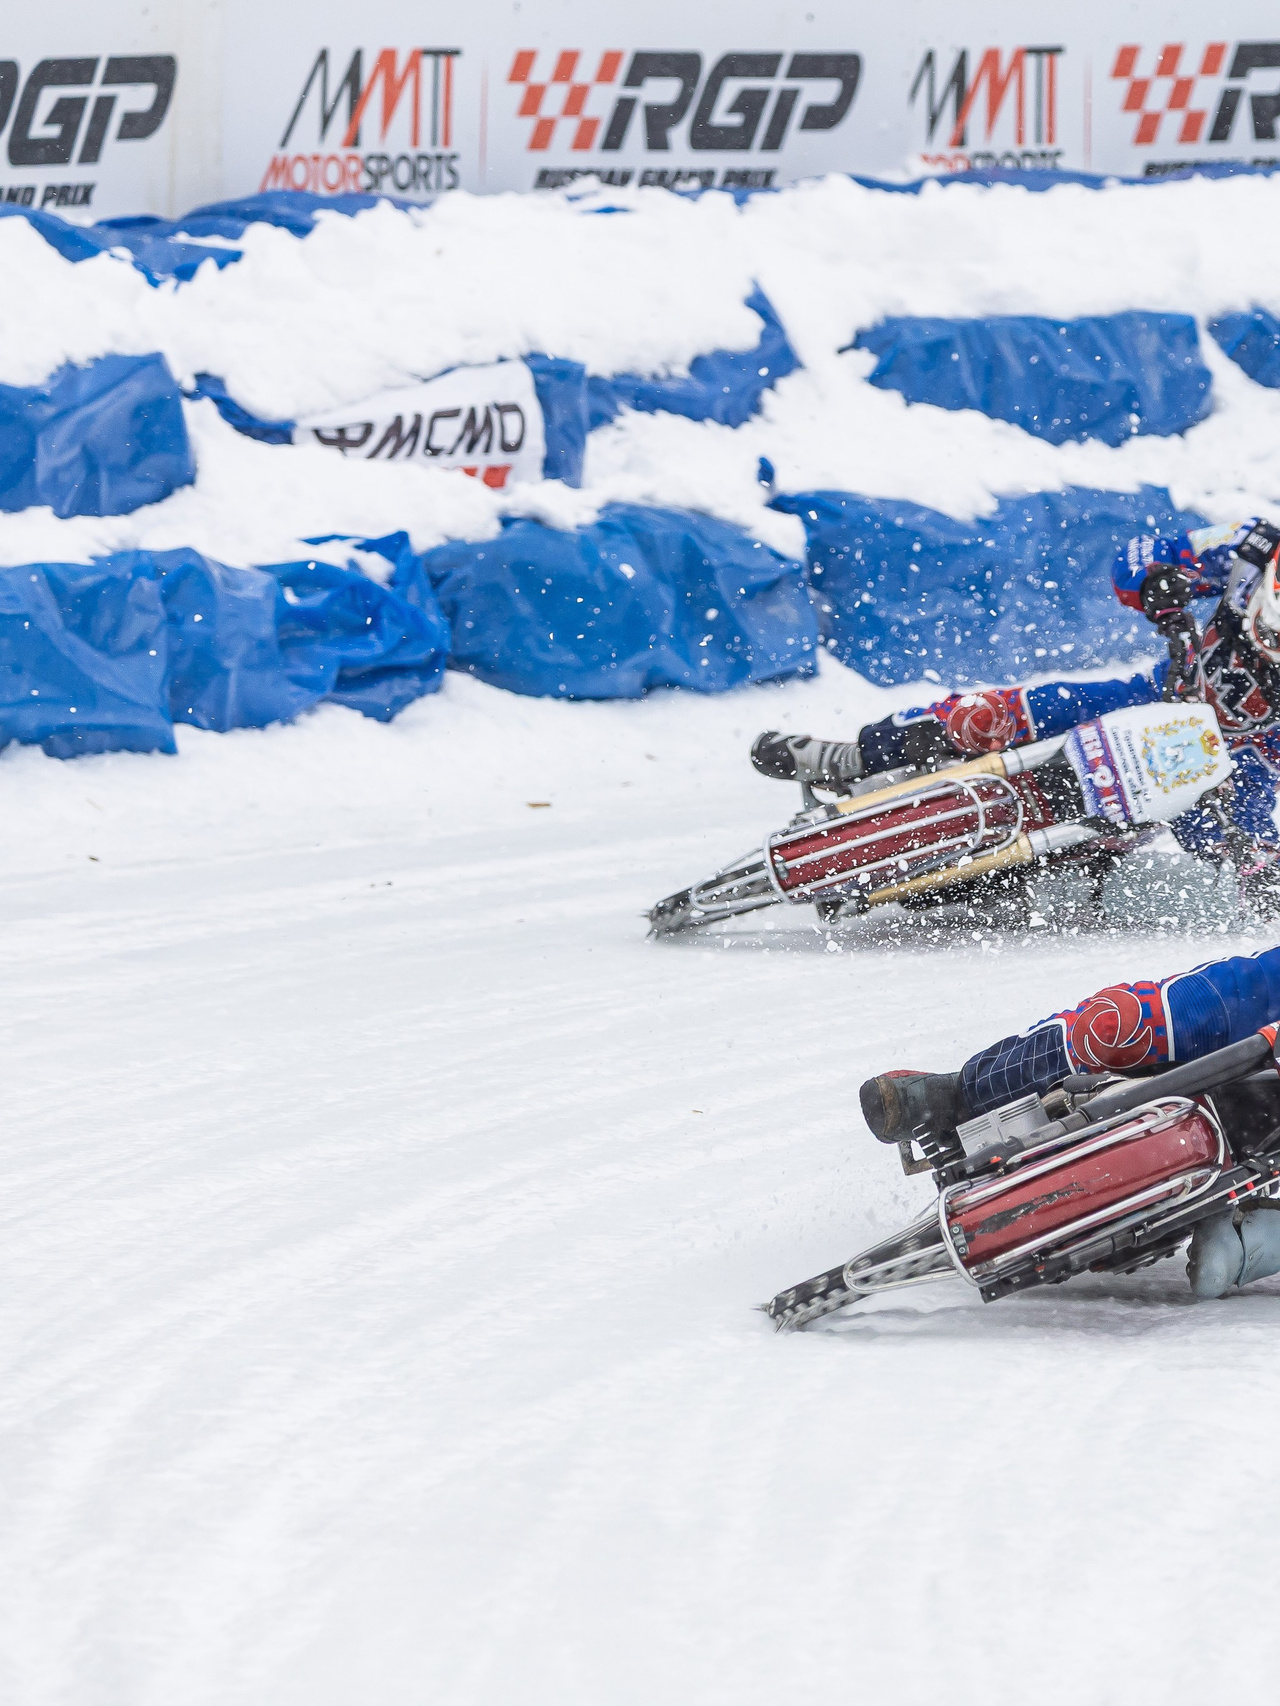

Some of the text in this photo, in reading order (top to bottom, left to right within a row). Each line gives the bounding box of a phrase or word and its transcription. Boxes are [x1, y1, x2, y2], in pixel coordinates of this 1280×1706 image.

[0, 54, 178, 166] GP
[602, 50, 864, 151] RGP
[41, 183, 95, 208] PRIX
[258, 153, 460, 193] MOTORSPORTS
